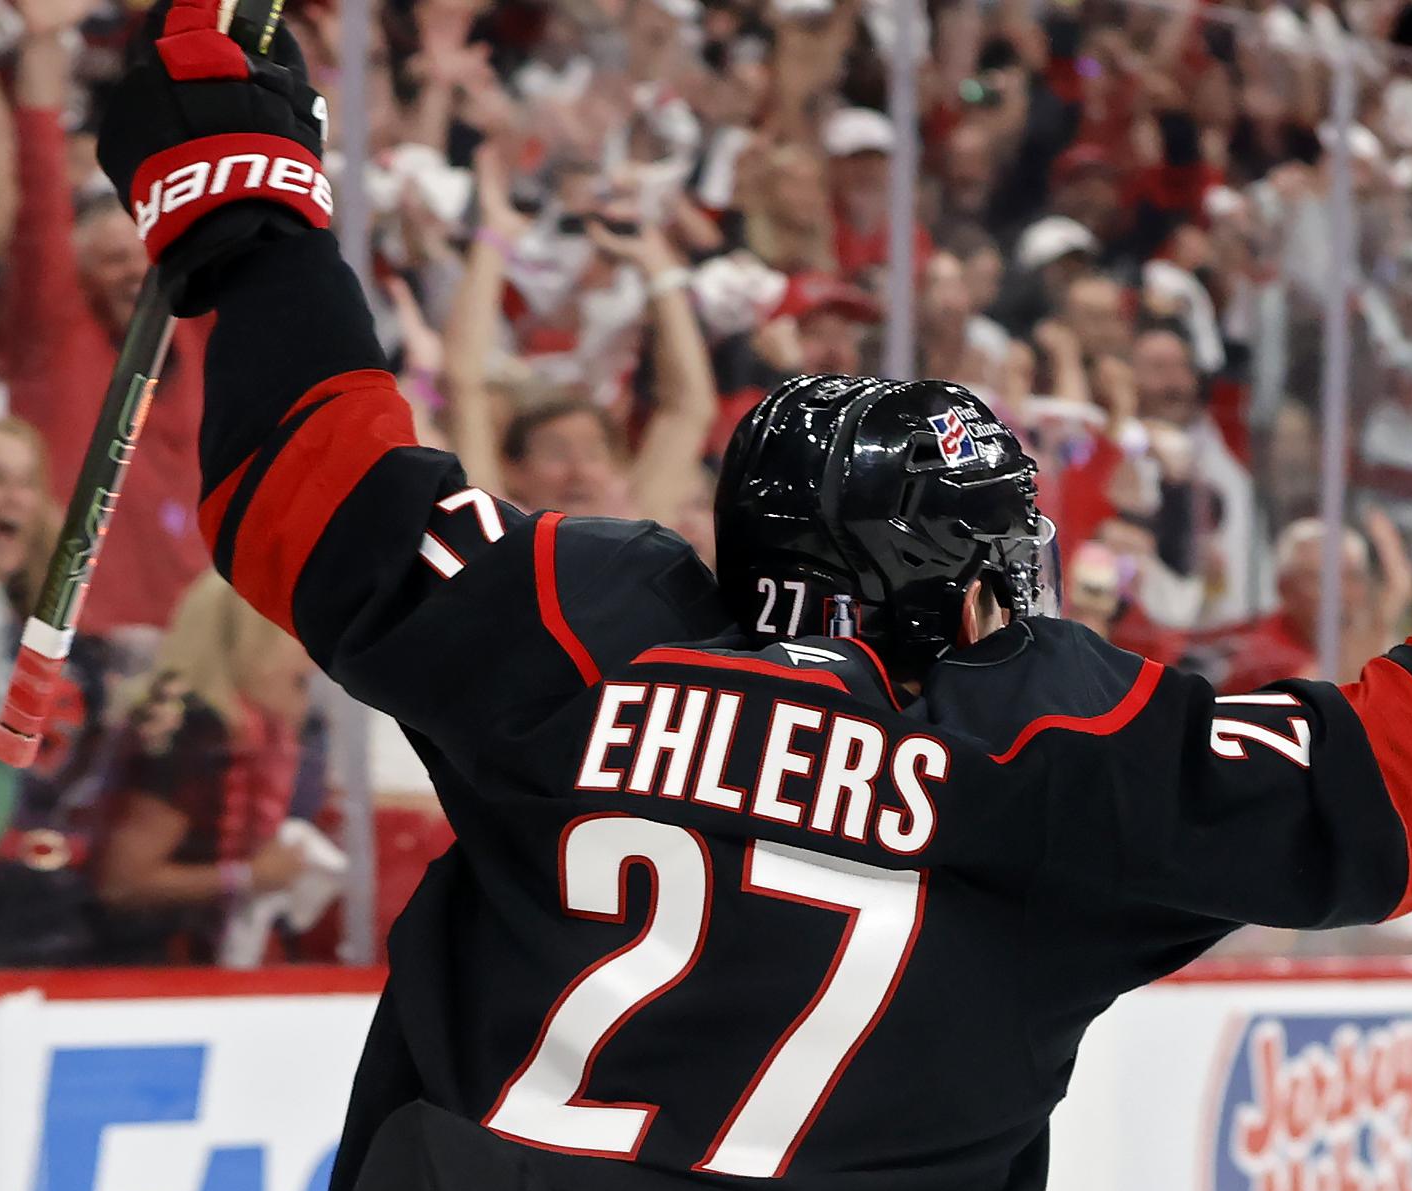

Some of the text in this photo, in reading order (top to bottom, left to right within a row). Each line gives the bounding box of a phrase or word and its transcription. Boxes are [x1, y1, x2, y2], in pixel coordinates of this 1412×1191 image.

[756, 577, 805, 637] 27
[574, 680, 951, 856] EHLERS
[481, 811, 929, 1179] 27
